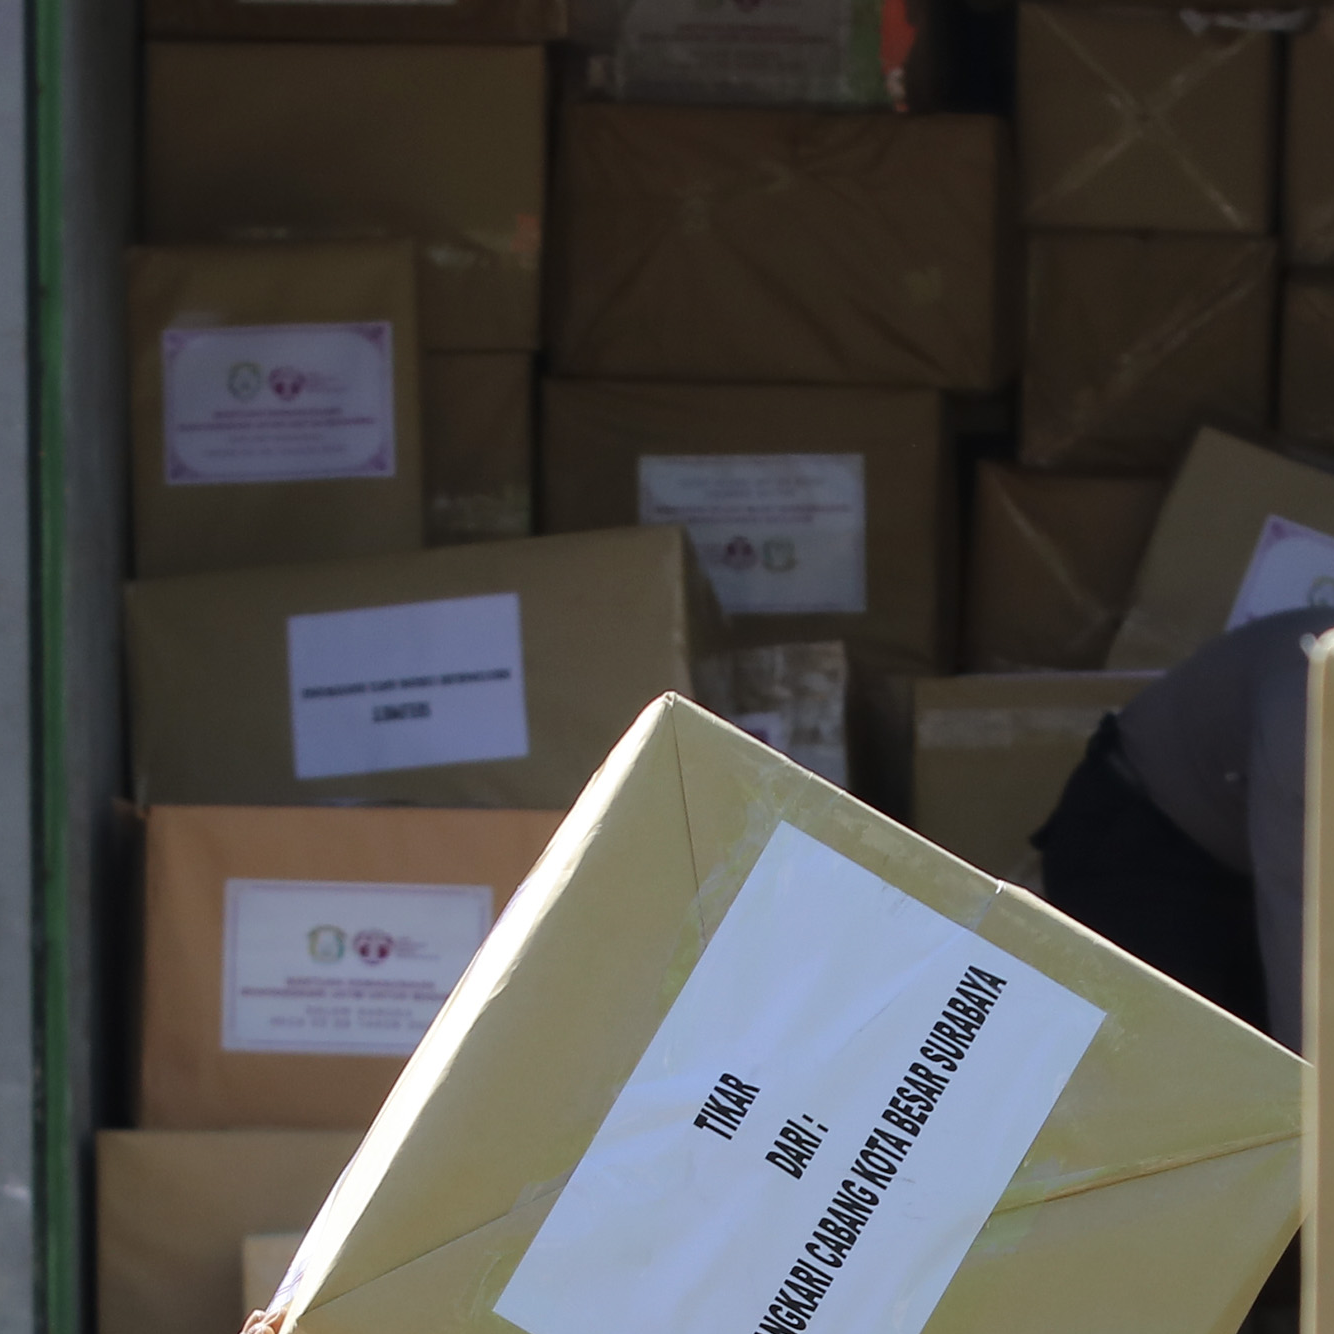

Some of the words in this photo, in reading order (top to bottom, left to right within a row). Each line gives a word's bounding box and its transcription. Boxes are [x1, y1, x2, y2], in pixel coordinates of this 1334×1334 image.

[919, 965, 1007, 1072] SURABAYA
[693, 1073, 760, 1140] TIKAR
[881, 1062, 950, 1138] BESAR
[765, 1119, 822, 1180] DARI
[850, 1127, 913, 1190] KOTA
[804, 1179, 880, 1268] CABANG
